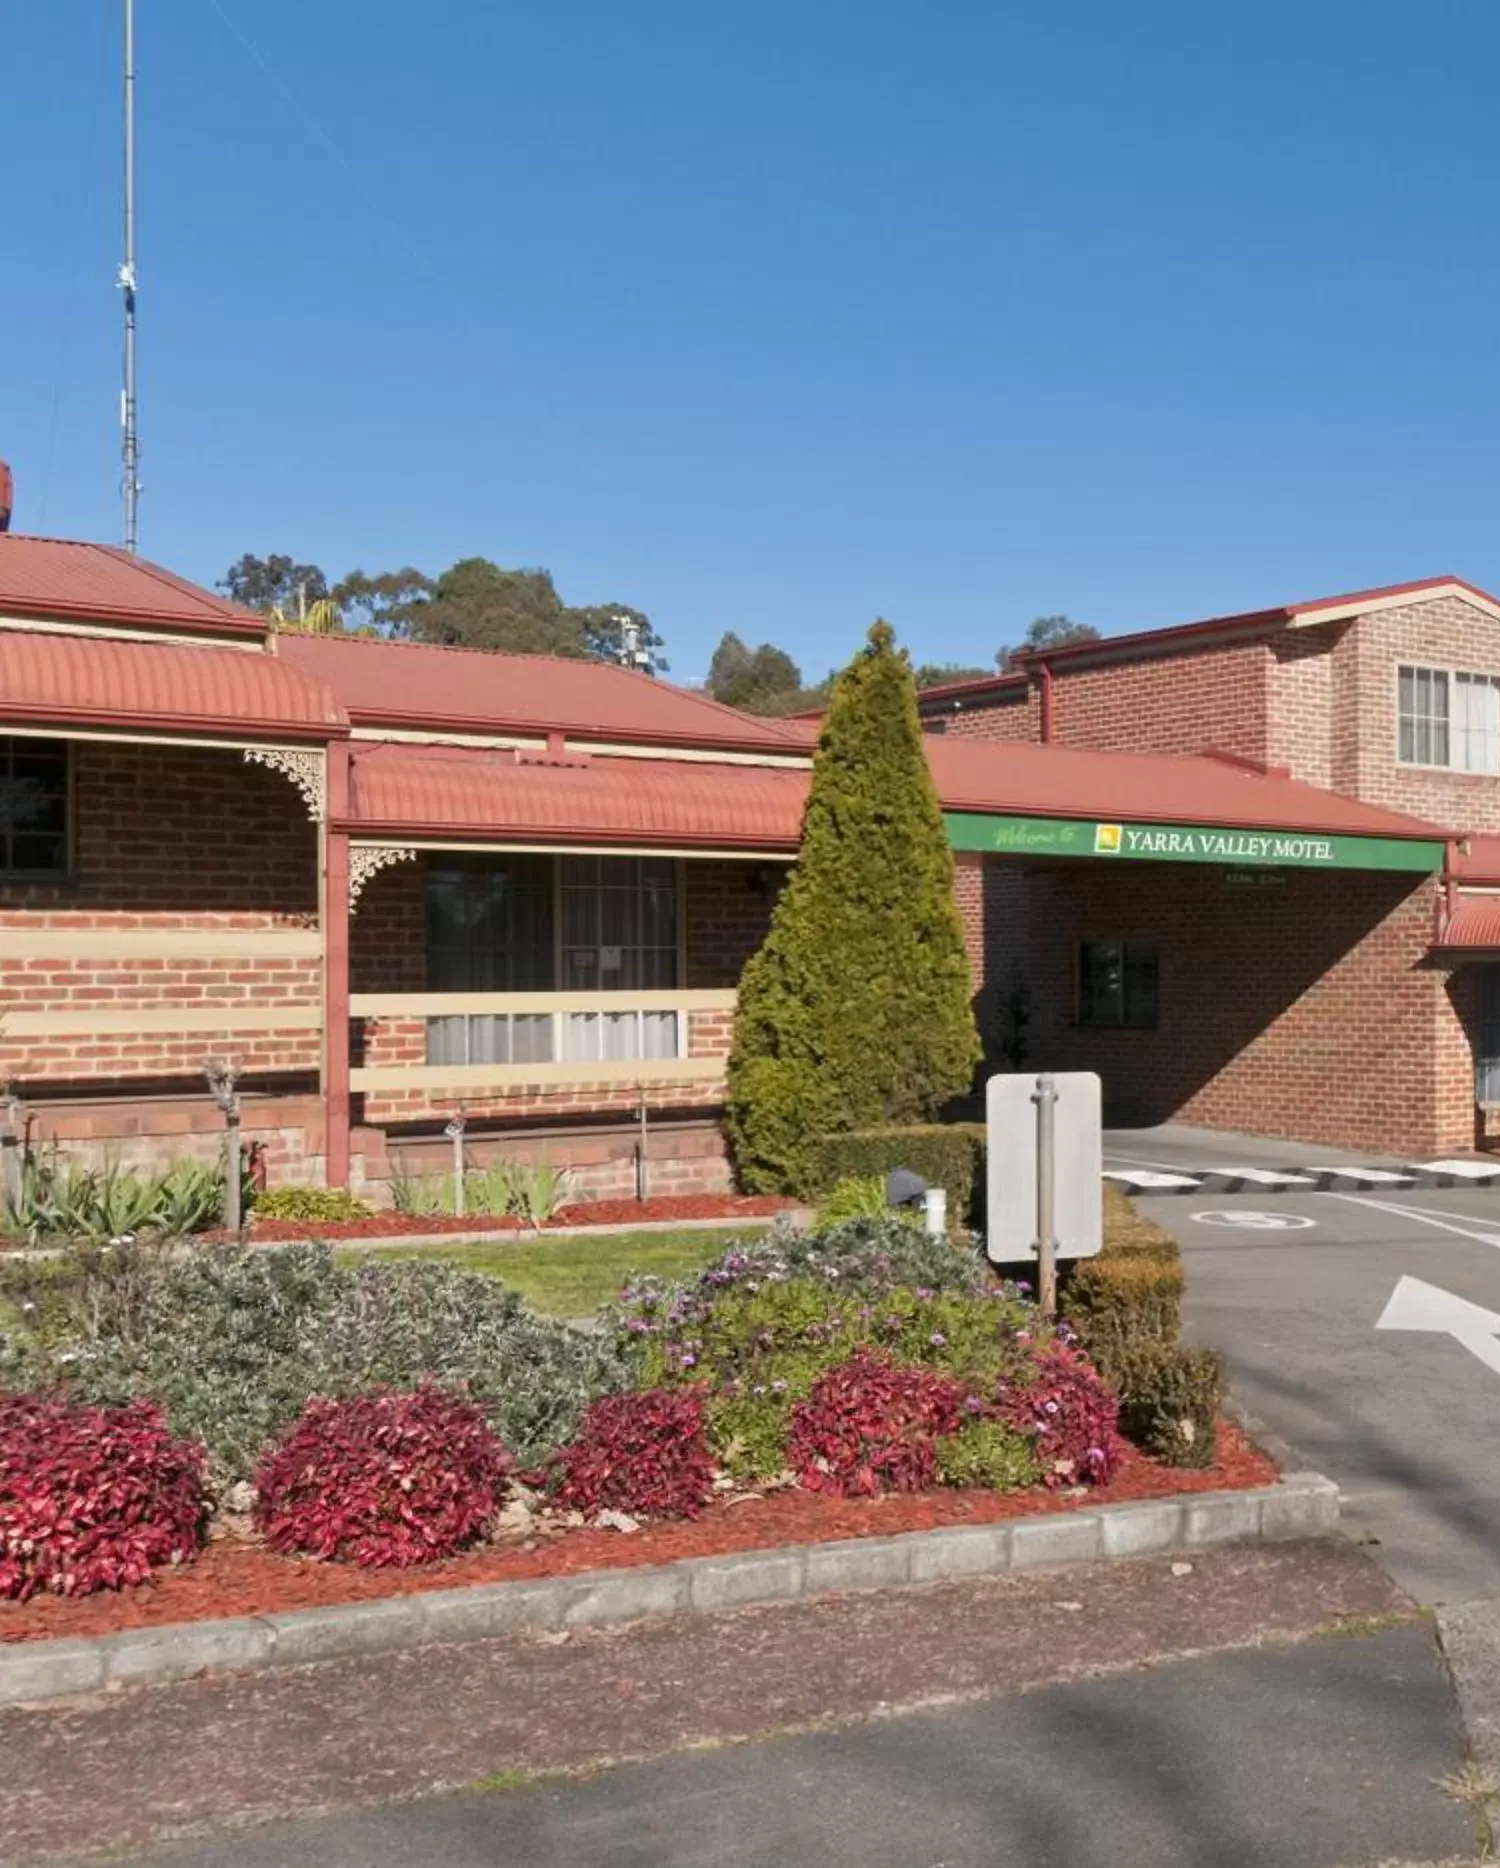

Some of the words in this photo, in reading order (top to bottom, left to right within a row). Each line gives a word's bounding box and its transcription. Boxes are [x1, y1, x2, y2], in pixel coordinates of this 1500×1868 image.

[1127, 831, 1195, 853] YARRA
[1200, 835, 1272, 857] VALLEY
[1272, 839, 1334, 860] MOTEL
